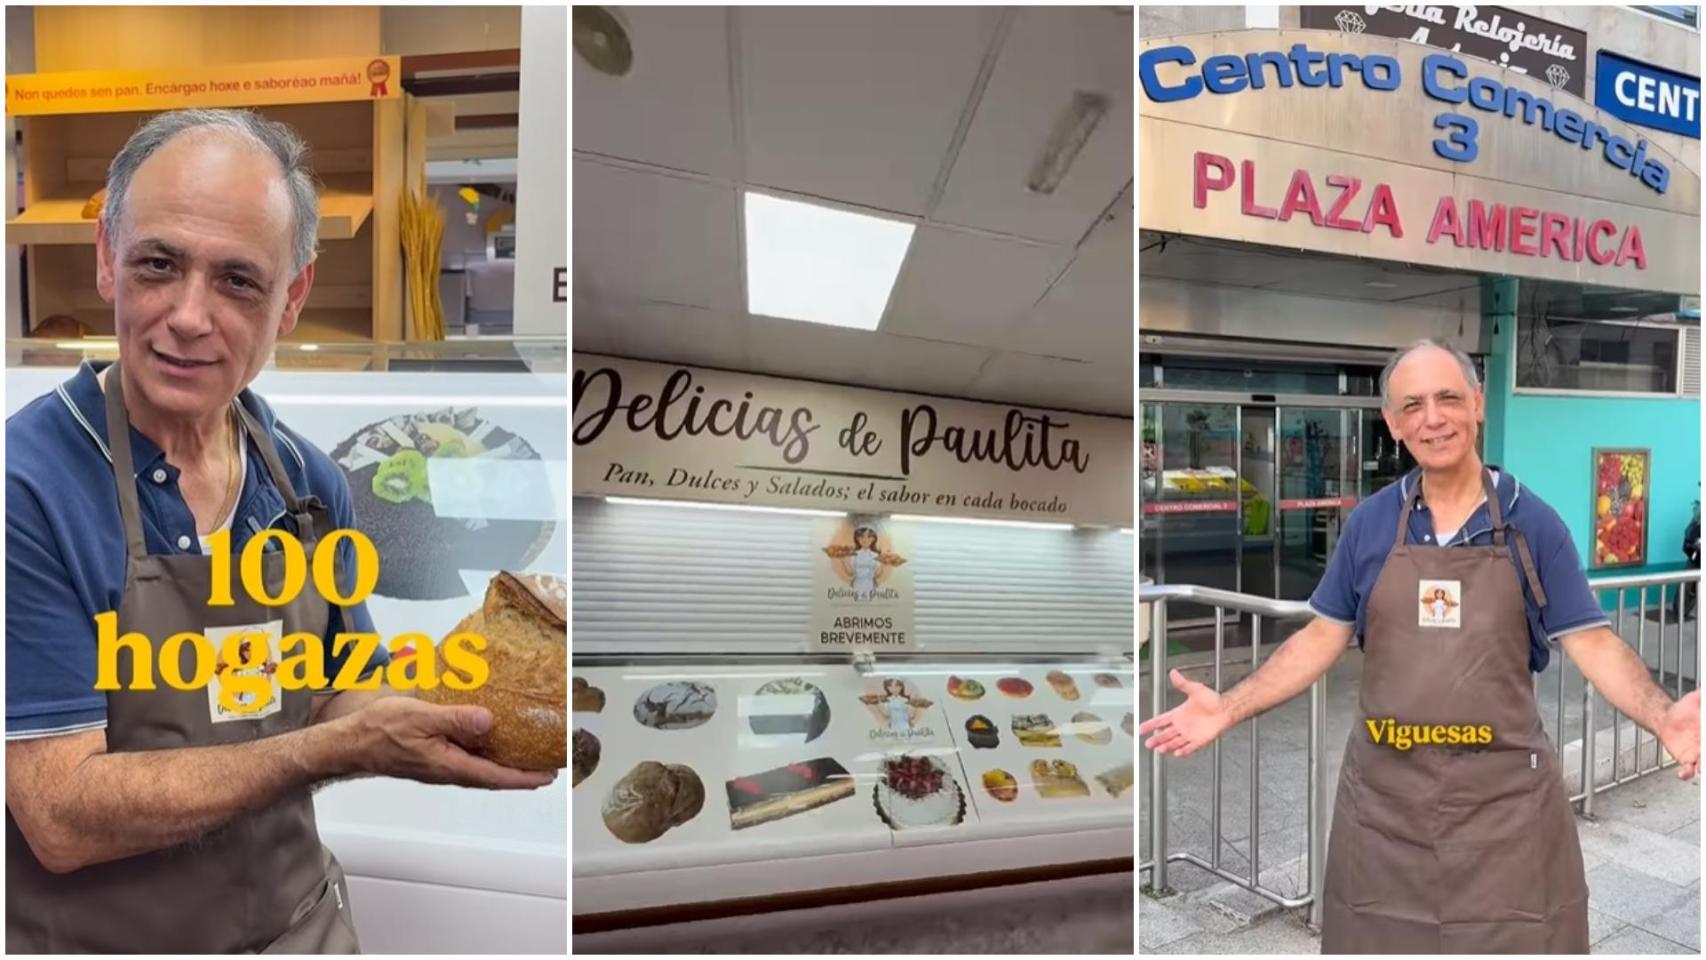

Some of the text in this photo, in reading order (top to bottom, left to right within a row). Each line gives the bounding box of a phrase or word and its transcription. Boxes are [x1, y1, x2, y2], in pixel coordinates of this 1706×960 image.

[1454, 5, 1576, 61] Relojería
[15, 89, 40, 101] Non
[42, 88, 87, 102] quedes
[90, 87, 113, 99] sen
[146, 80, 207, 97] Encárgao
[210, 80, 241, 92] hoxe
[243, 82, 252, 91] e
[254, 76, 317, 91] saboréao
[1614, 71, 1700, 122] CENT
[1139, 43, 1401, 103] Centro
[1421, 53, 1672, 195] Comercia
[1433, 112, 1479, 163] 3
[1193, 151, 1647, 270] PLAZA AMERICA
[571, 367, 1090, 475] Delicias de Paulita
[602, 463, 1068, 514] Pan, Dulces y Salados; el sabor en cada bocado
[820, 631, 906, 645] BREVEMENTE
[834, 616, 893, 630] ABRIMOS
